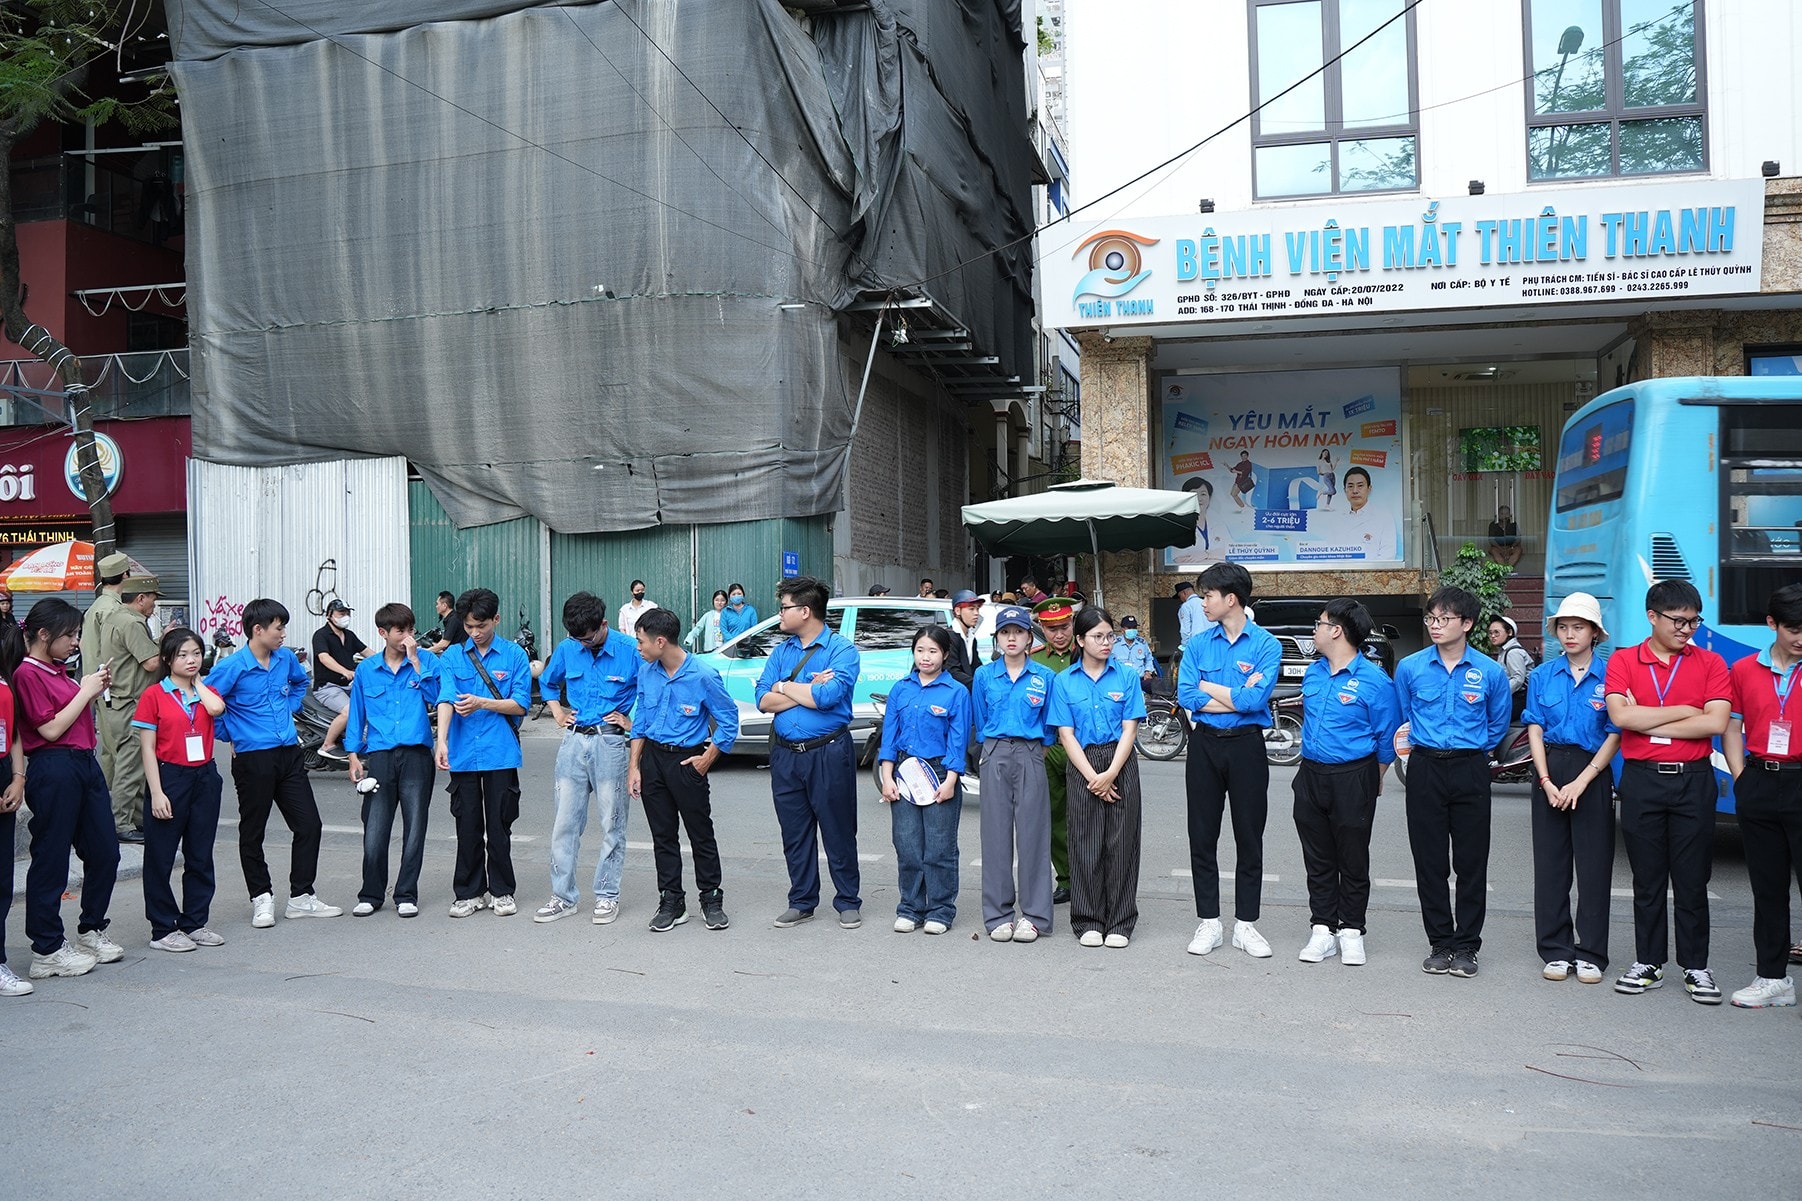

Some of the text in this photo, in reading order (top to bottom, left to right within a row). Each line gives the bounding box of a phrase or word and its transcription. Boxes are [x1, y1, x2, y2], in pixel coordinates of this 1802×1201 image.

[1176, 201, 1736, 289] BỆNH VIỆN MẮT THIÊN THANH
[1431, 276, 1511, 290] NƠI CẤP: BỘ Y TẾ
[1522, 276, 1539, 286] PHỤ
[1541, 273, 1567, 284] TRÁCH
[1569, 273, 1585, 283] CM:
[1586, 271, 1605, 282] TIẾN
[1621, 270, 1639, 281] BÁC
[1650, 270, 1667, 279] CAO
[1669, 267, 1686, 278] CẤP
[1688, 267, 1698, 277] LÊ
[1723, 264, 1752, 275] QUỲNH
[1204, 291, 1218, 302] SỐ:
[1221, 291, 1258, 302] 326/BYT
[1304, 286, 1327, 297] NGÀY
[1522, 287, 1559, 297] HOTLINE:
[1560, 285, 1616, 296] 0388.967.699
[1627, 281, 1689, 293] 0243.2265.999
[1078, 298, 1154, 318] THIÊN THANH
[1178, 306, 1198, 315] ADD:
[1200, 306, 1214, 314] 168
[1220, 304, 1235, 312] 170
[1238, 302, 1258, 312] THÁI
[1260, 302, 1287, 312] THỊNH
[1294, 298, 1318, 308] ĐỐNG
[1322, 299, 1334, 308] ĐA
[1342, 297, 1354, 306] HÀ
[1358, 296, 1374, 306] NỘI
[1228, 410, 1272, 431] YÊU
[1278, 405, 1332, 429] MẮT
[1208, 431, 1353, 450] NGAY HÔM NAY
[1262, 516, 1300, 526] 2-6 TRIỆU
[11, 530, 36, 542] THÁI
[867, 672, 884, 681] 1900
